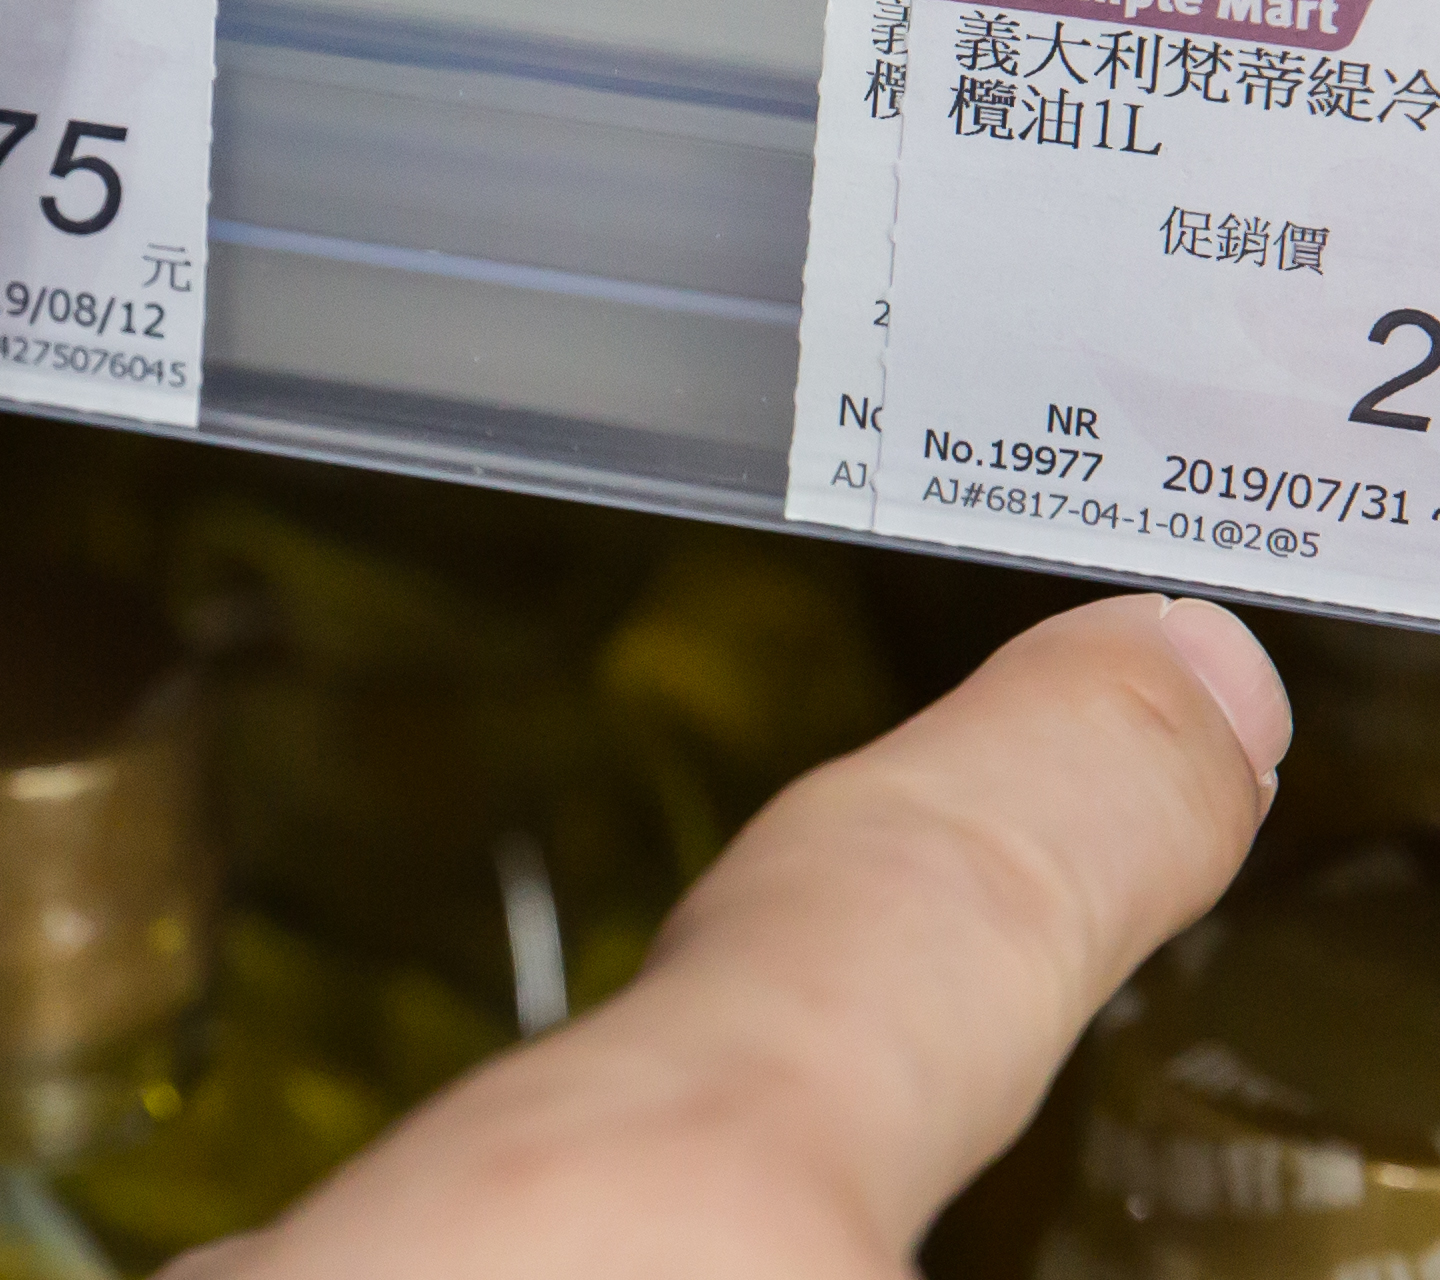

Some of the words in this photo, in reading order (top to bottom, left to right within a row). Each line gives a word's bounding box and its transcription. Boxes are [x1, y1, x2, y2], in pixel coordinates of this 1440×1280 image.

[947, 74, 1162, 156] 欖油1L
[141, 243, 193, 293] 元
[1160, 205, 1330, 275] 促銷價
[923, 429, 1103, 483] No.19977
[1047, 403, 1100, 440] NR
[922, 476, 1320, 558] AJ#6817-04-1-01@2@5
[1162, 455, 1411, 525] 2019/07/31
